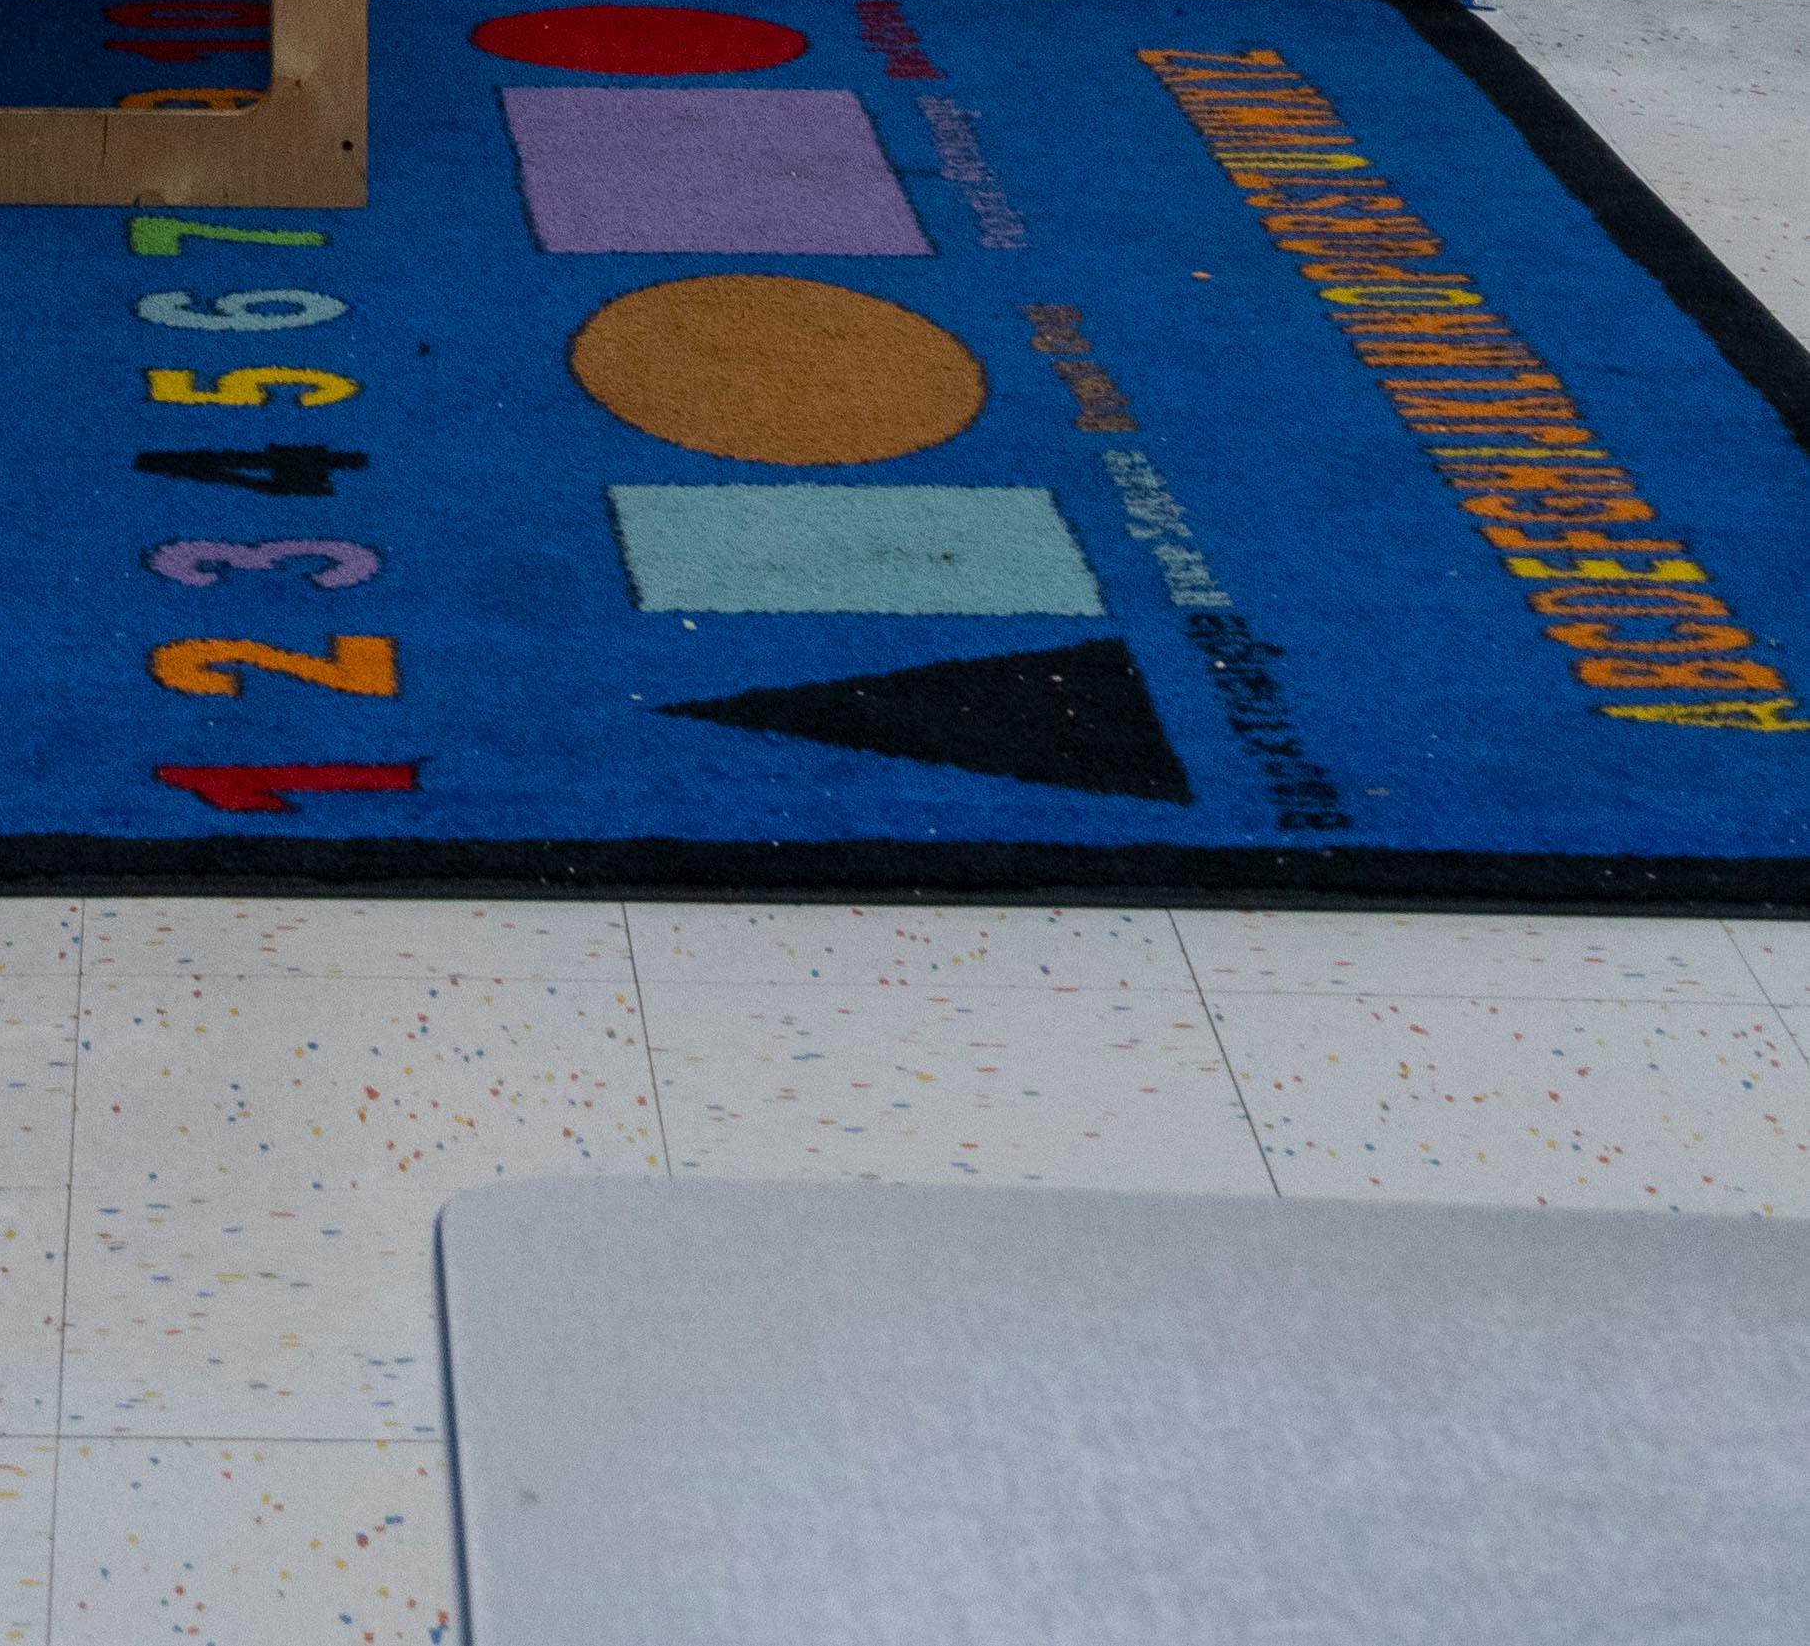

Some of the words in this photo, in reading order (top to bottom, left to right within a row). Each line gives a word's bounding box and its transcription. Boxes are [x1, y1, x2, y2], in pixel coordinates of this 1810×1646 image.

[128, 215, 329, 256] 7
[134, 286, 351, 333] 6
[144, 365, 362, 408] 5
[132, 442, 370, 497] 4
[144, 538, 382, 590] 3
[148, 634, 401, 699] 2
[154, 760, 422, 814] 1
